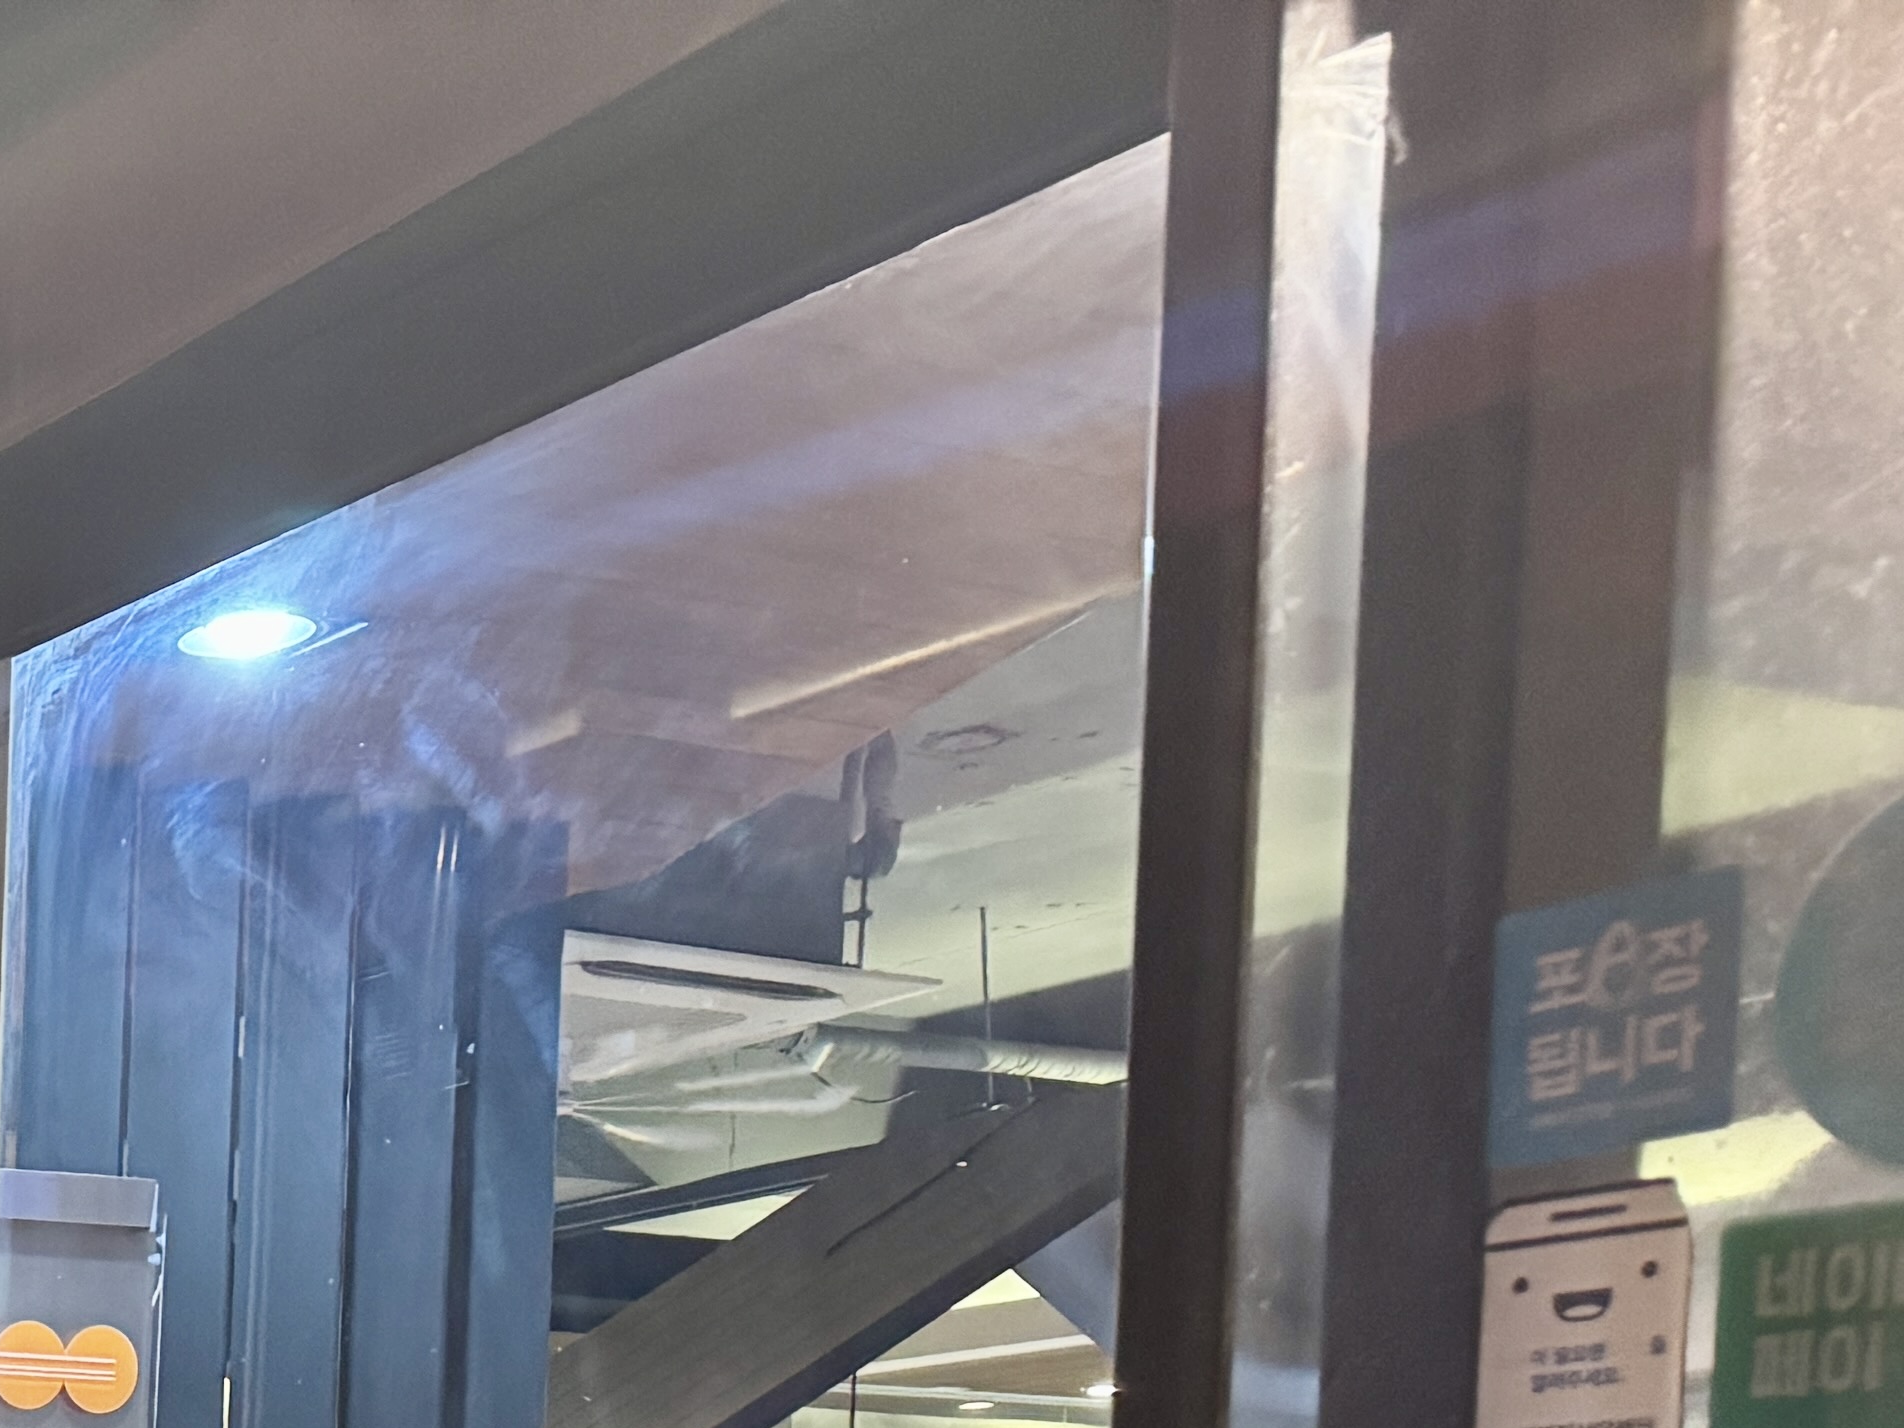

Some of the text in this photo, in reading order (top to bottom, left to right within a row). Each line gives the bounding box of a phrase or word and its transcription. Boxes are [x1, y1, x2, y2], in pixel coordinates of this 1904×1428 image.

[1530, 919, 1710, 1013] 포장
[1528, 1005, 1706, 1101] 됩니다
[1754, 1238, 1904, 1318] 네이
[1751, 1320, 1885, 1399] 페이
